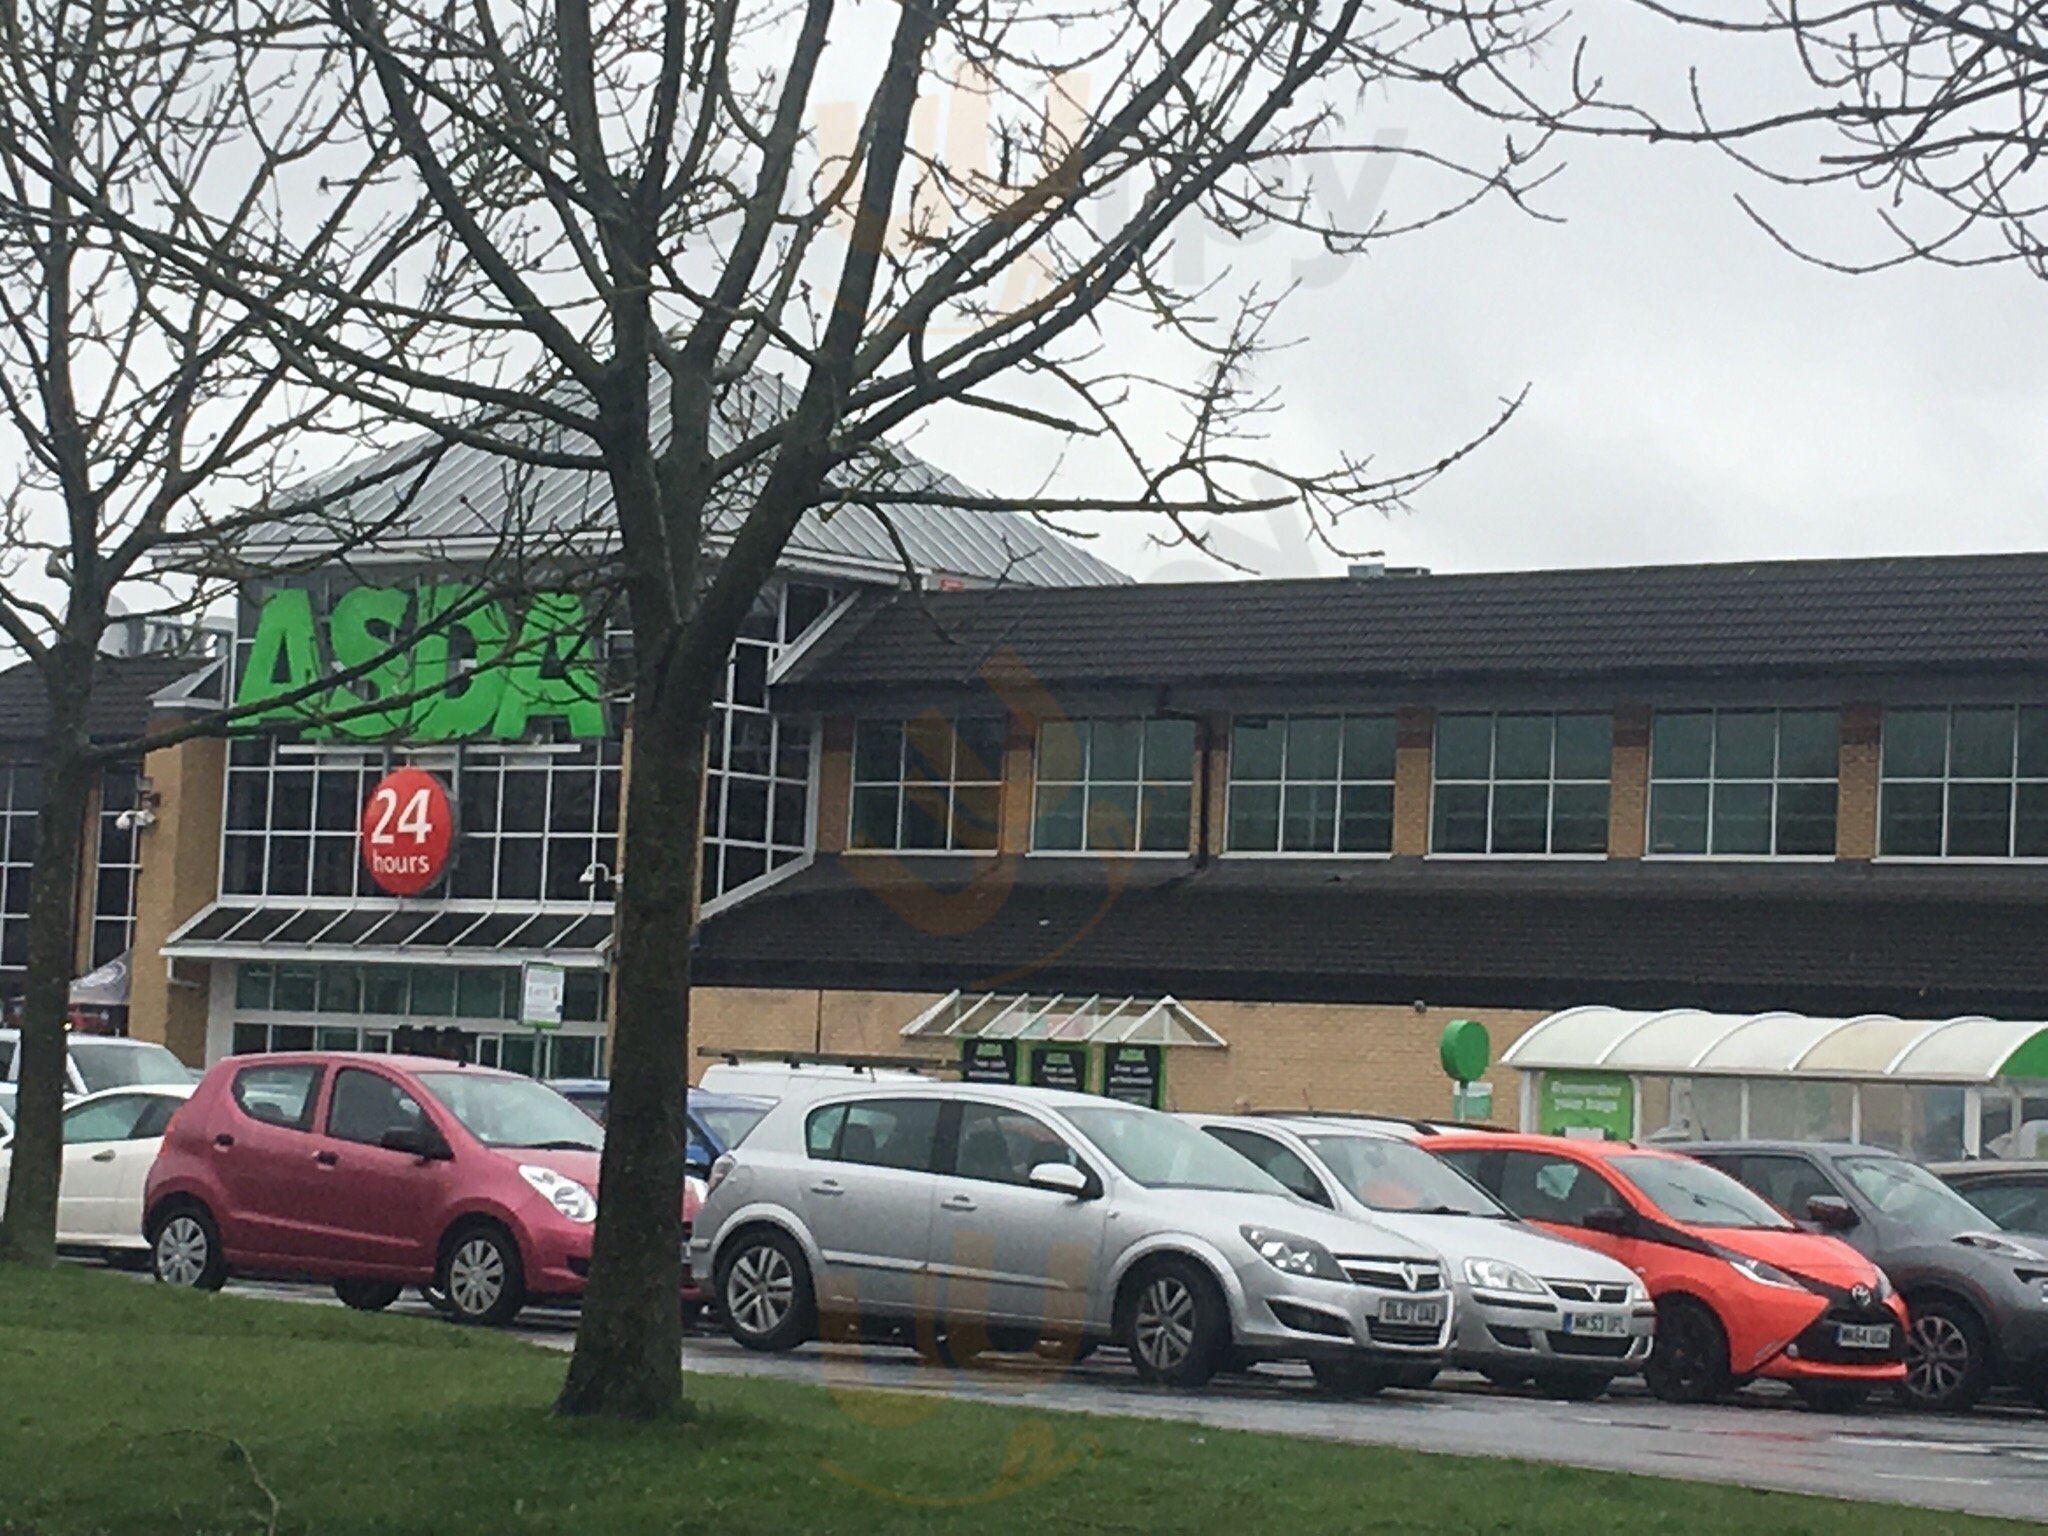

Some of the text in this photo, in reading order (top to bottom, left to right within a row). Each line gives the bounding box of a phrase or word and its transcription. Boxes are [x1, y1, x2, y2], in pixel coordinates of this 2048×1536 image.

[228, 584, 605, 739] ASDA
[371, 788, 433, 844] 24
[372, 849, 430, 873] hours
